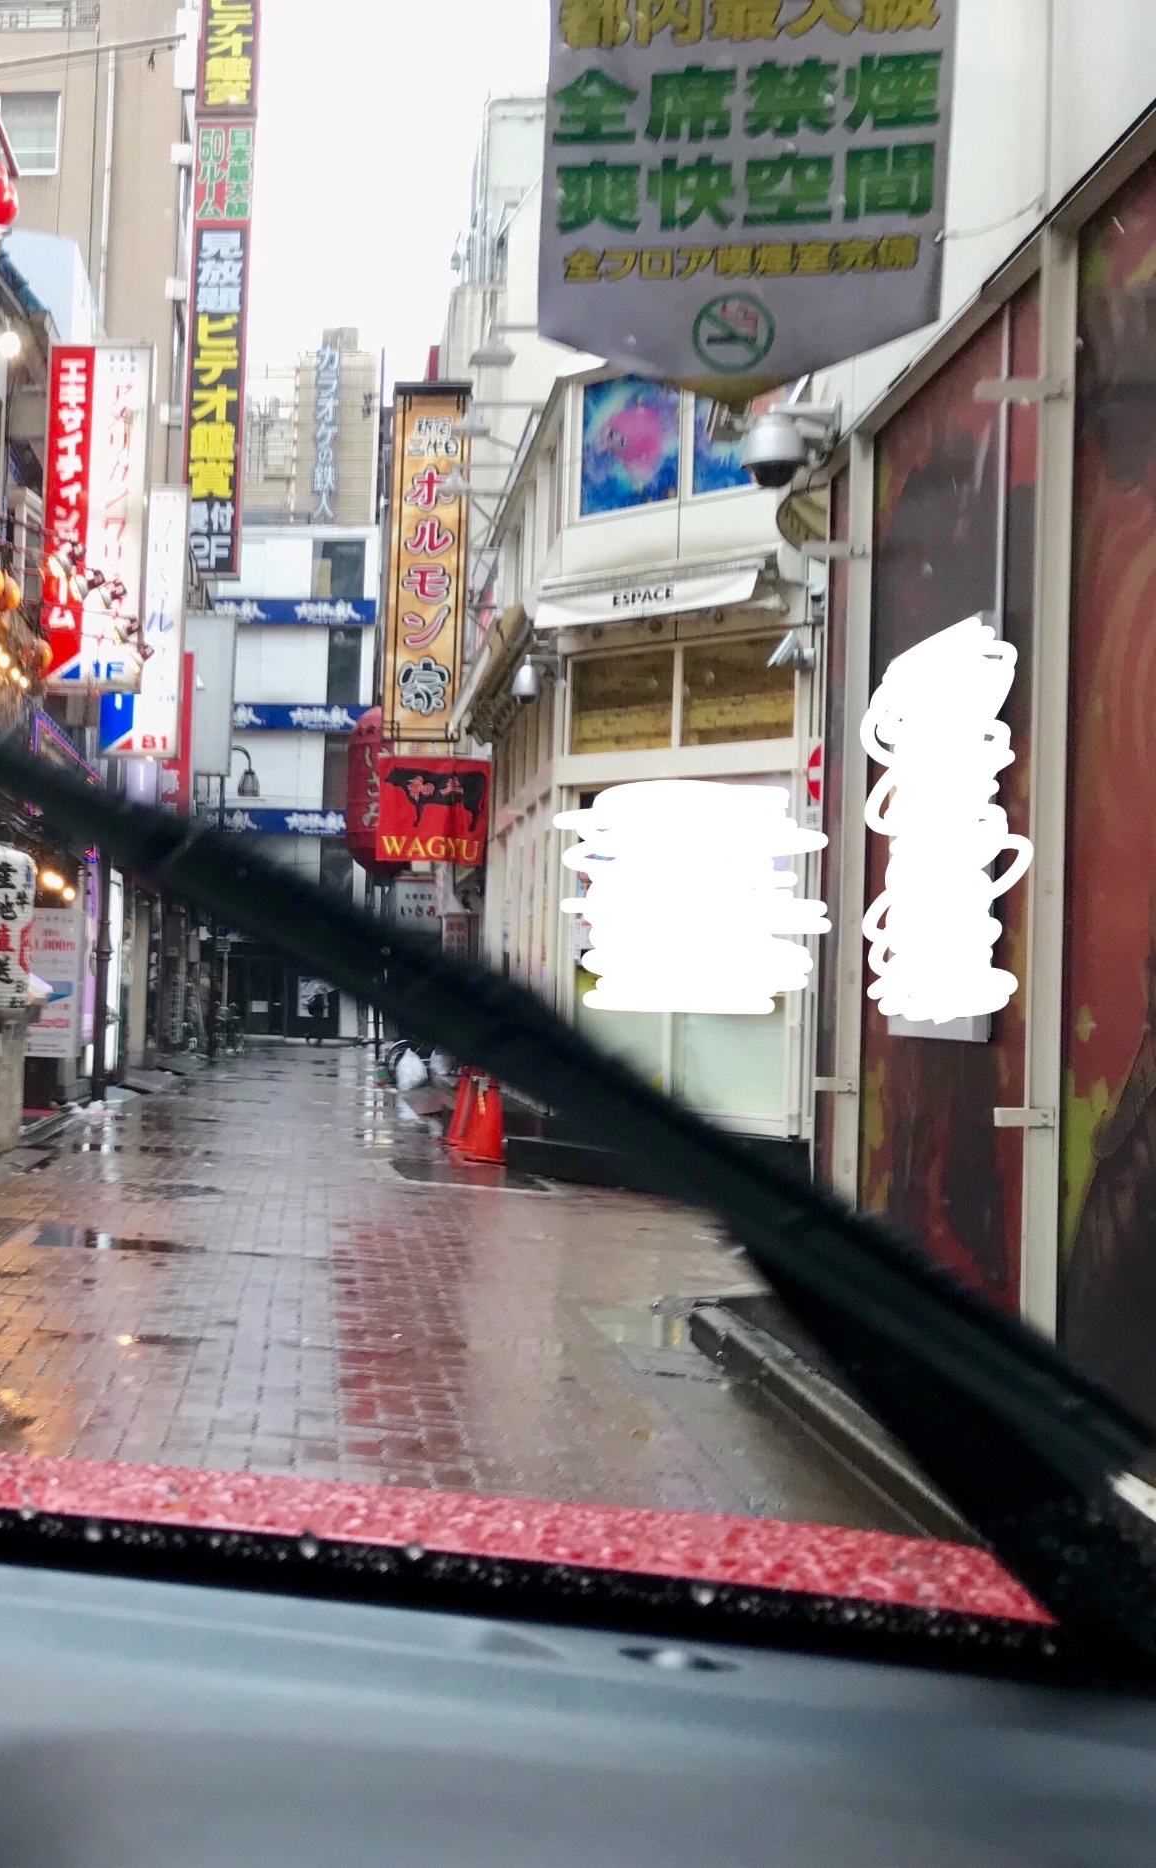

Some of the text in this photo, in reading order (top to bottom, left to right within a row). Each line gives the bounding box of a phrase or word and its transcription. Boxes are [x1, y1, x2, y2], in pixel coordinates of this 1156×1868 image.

[552, 50, 943, 146] 全席禁煙
[555, 141, 936, 236] 爽快空間
[188, 313, 240, 499] ビデオ鑑賞
[399, 466, 451, 712] ホルモン家
[613, 586, 675, 609] ESPACE
[141, 734, 168, 750] B1
[380, 835, 480, 862] WAGYU
